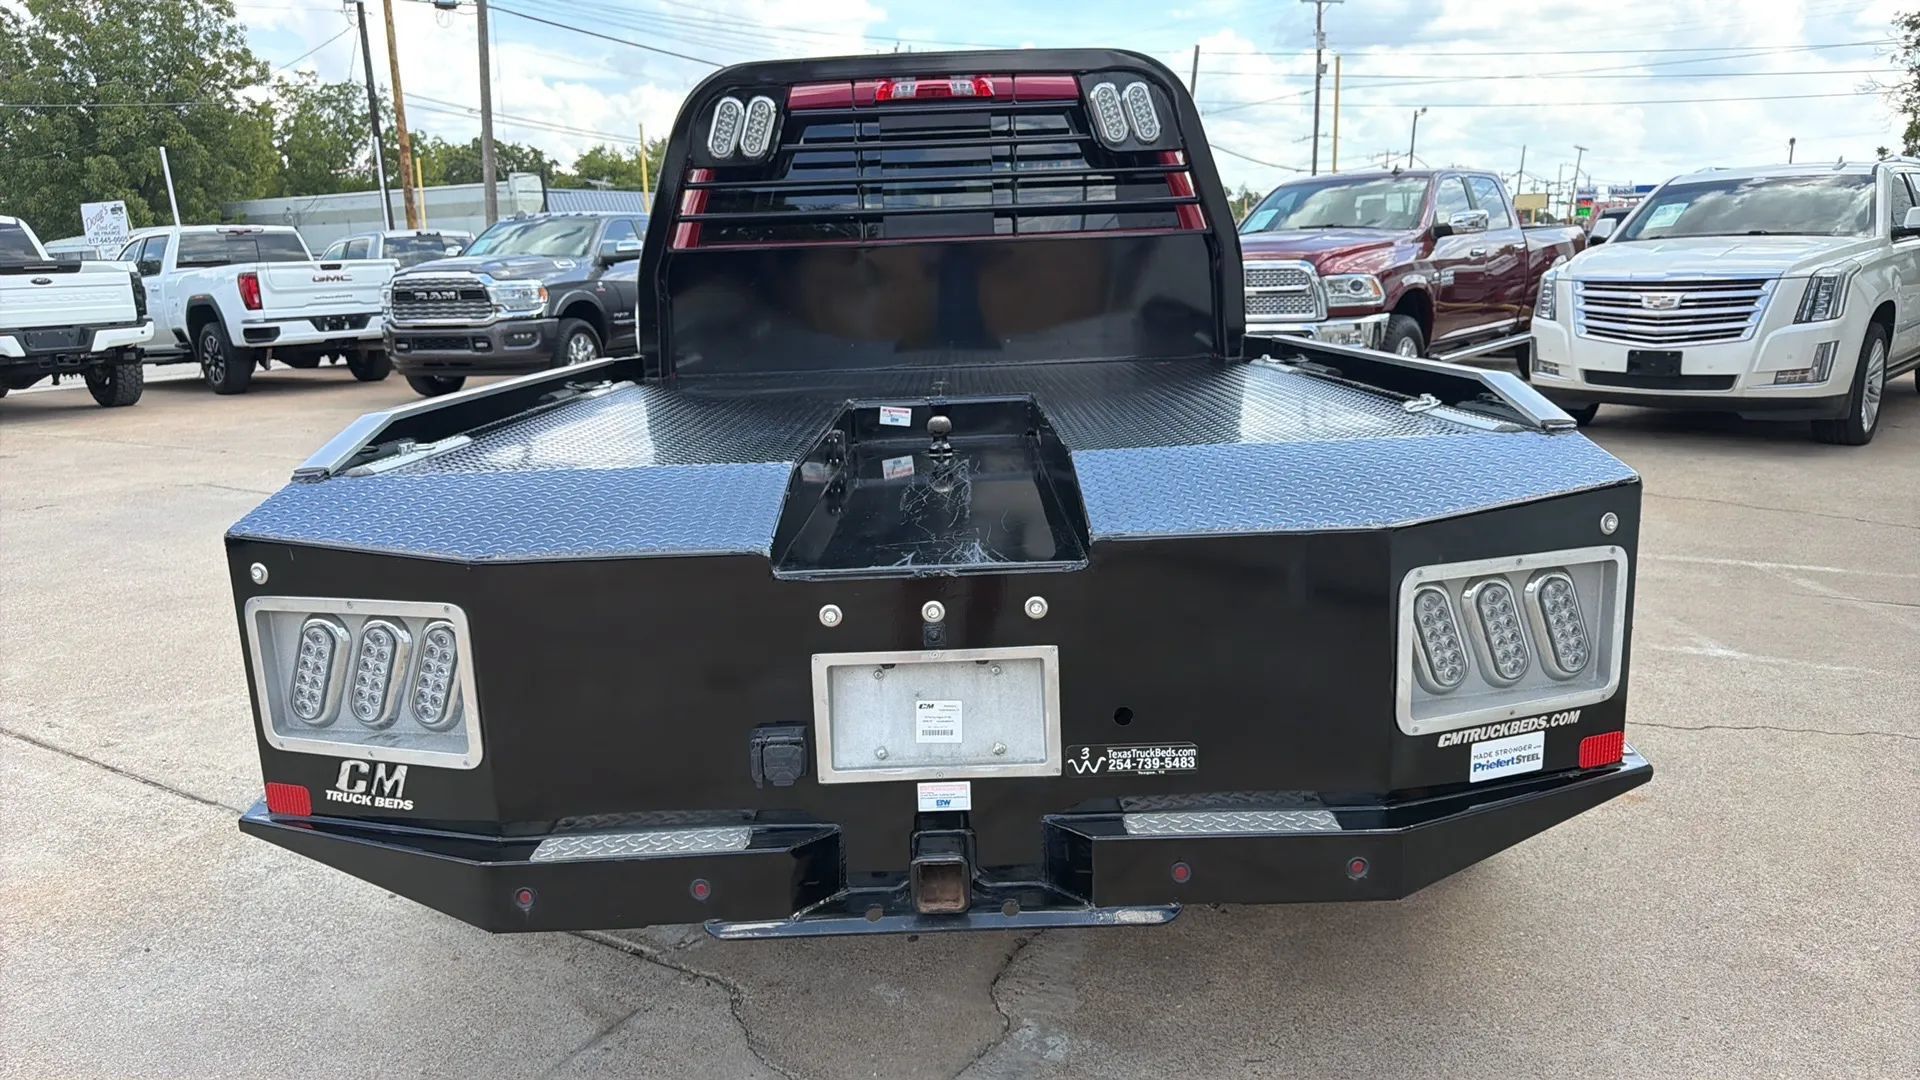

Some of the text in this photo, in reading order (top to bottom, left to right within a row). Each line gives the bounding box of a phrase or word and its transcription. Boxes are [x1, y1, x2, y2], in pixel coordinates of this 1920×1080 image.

[1611, 187, 1634, 195] Mobil
[312, 274, 353, 282] GMC
[414, 291, 456, 300] RAM
[1437, 710, 1581, 748] CMTRUCKBEDS.COM
[1107, 748, 1197, 759] TexasTruckBeds.com
[1473, 751, 1493, 760] MADE
[1494, 744, 1532, 757] STRONGER
[1108, 757, 1195, 770] 254-739-5483
[336, 759, 409, 798] CM
[325, 789, 414, 811] TRUCK BEDS
